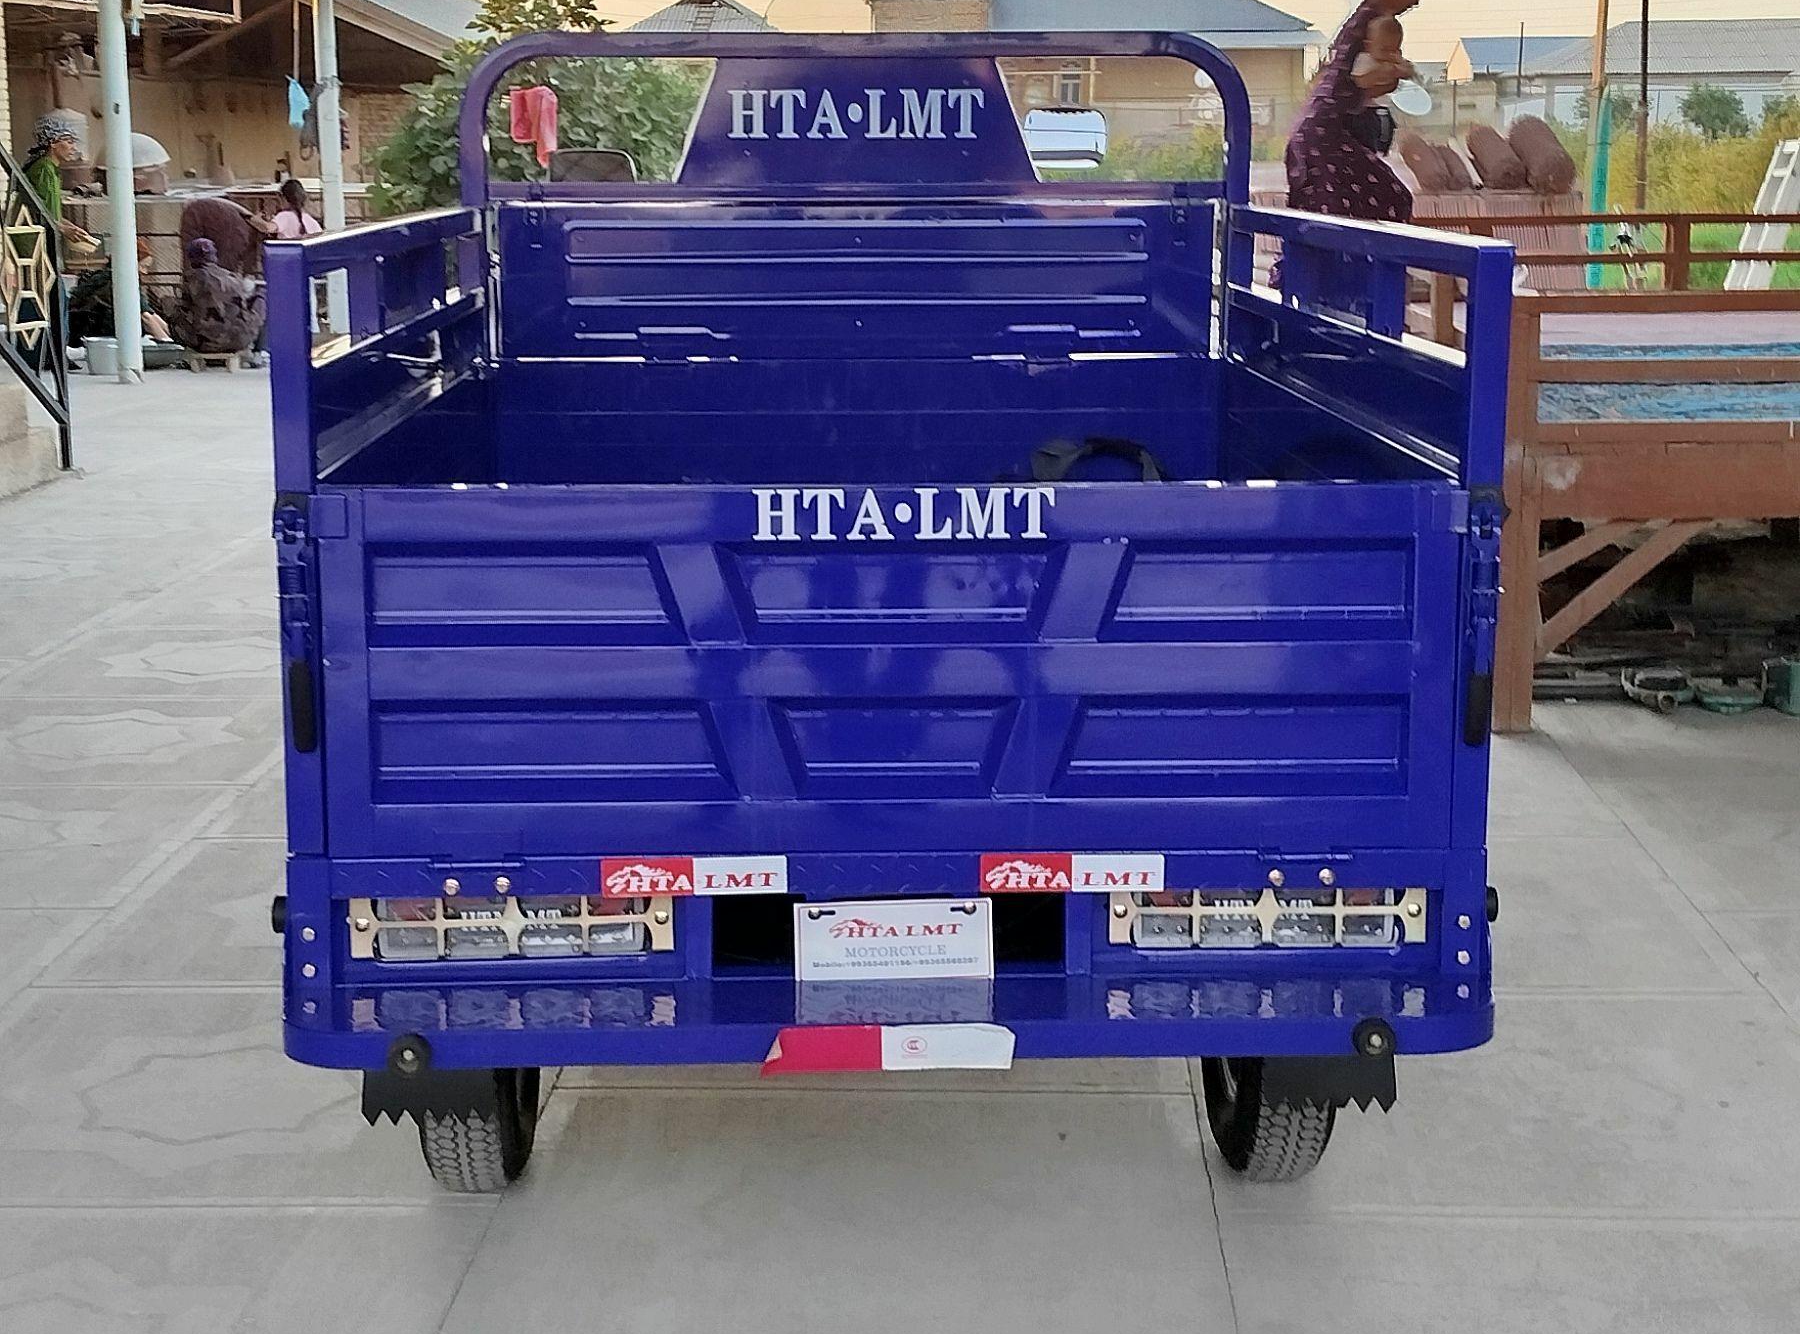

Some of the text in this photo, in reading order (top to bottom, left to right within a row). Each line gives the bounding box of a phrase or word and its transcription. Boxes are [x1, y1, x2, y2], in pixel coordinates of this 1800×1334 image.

[626, 872, 778, 893] HTA LMT
[1005, 871, 1156, 889] HTA LMT
[845, 923, 963, 938] HTA LMT
[844, 944, 947, 959] MOTORCYCLE
